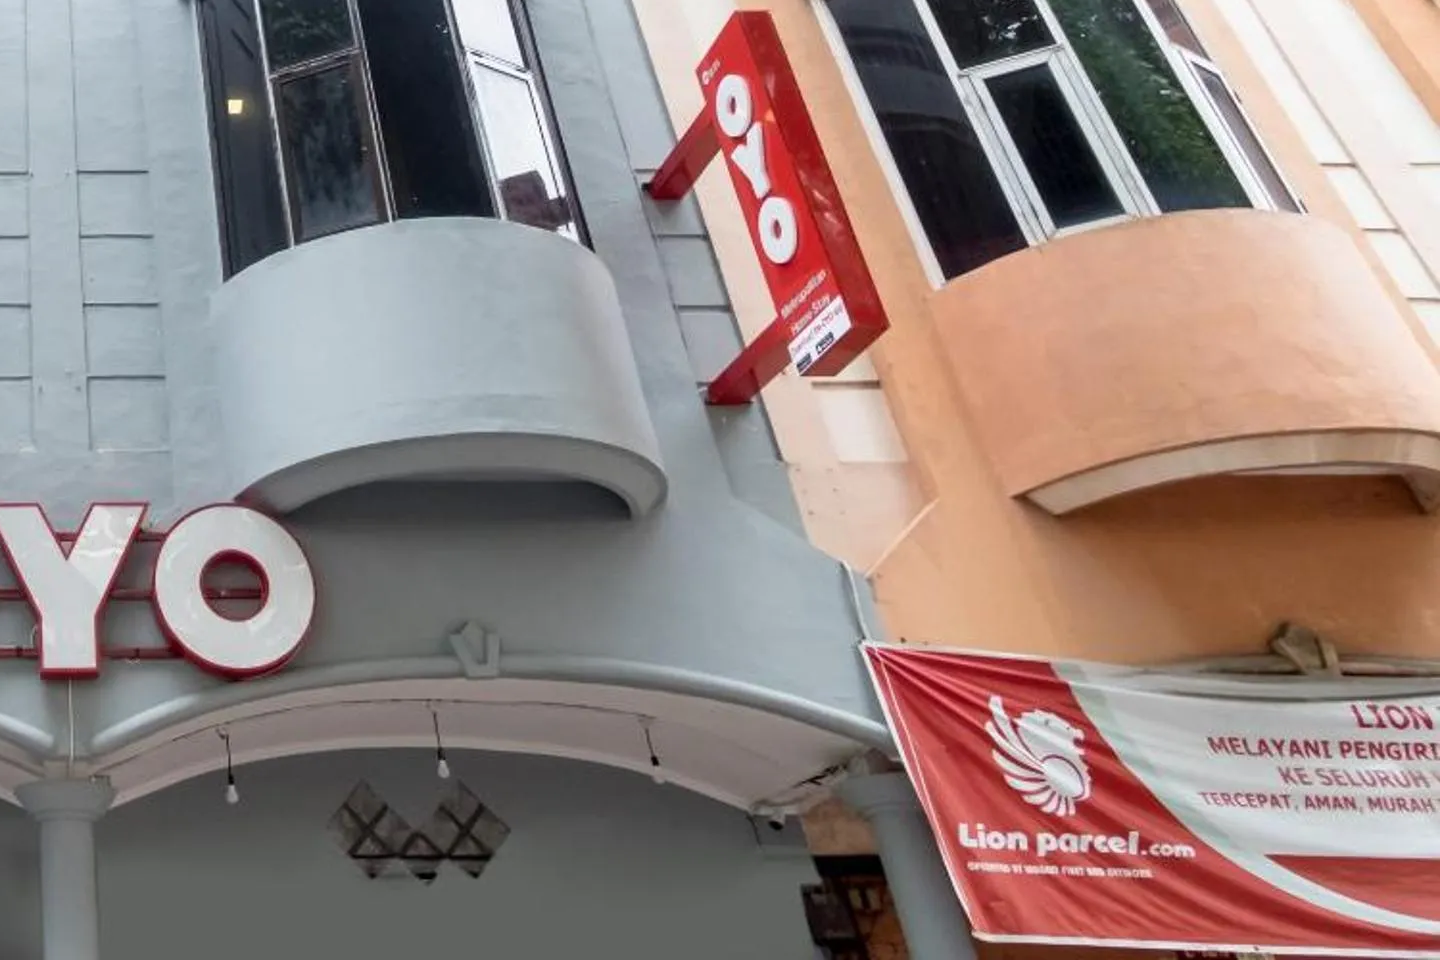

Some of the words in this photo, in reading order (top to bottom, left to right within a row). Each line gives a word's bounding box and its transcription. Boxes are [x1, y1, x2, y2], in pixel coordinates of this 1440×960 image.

[715, 73, 798, 265] OYO
[1351, 704, 1434, 730] LION
[1207, 737, 1333, 759] MELAYANI
[1277, 767, 1312, 785] KE
[1315, 767, 1431, 788] SELURUH
[1367, 797, 1436, 813] MURAH
[958, 823, 1029, 851] Lion
